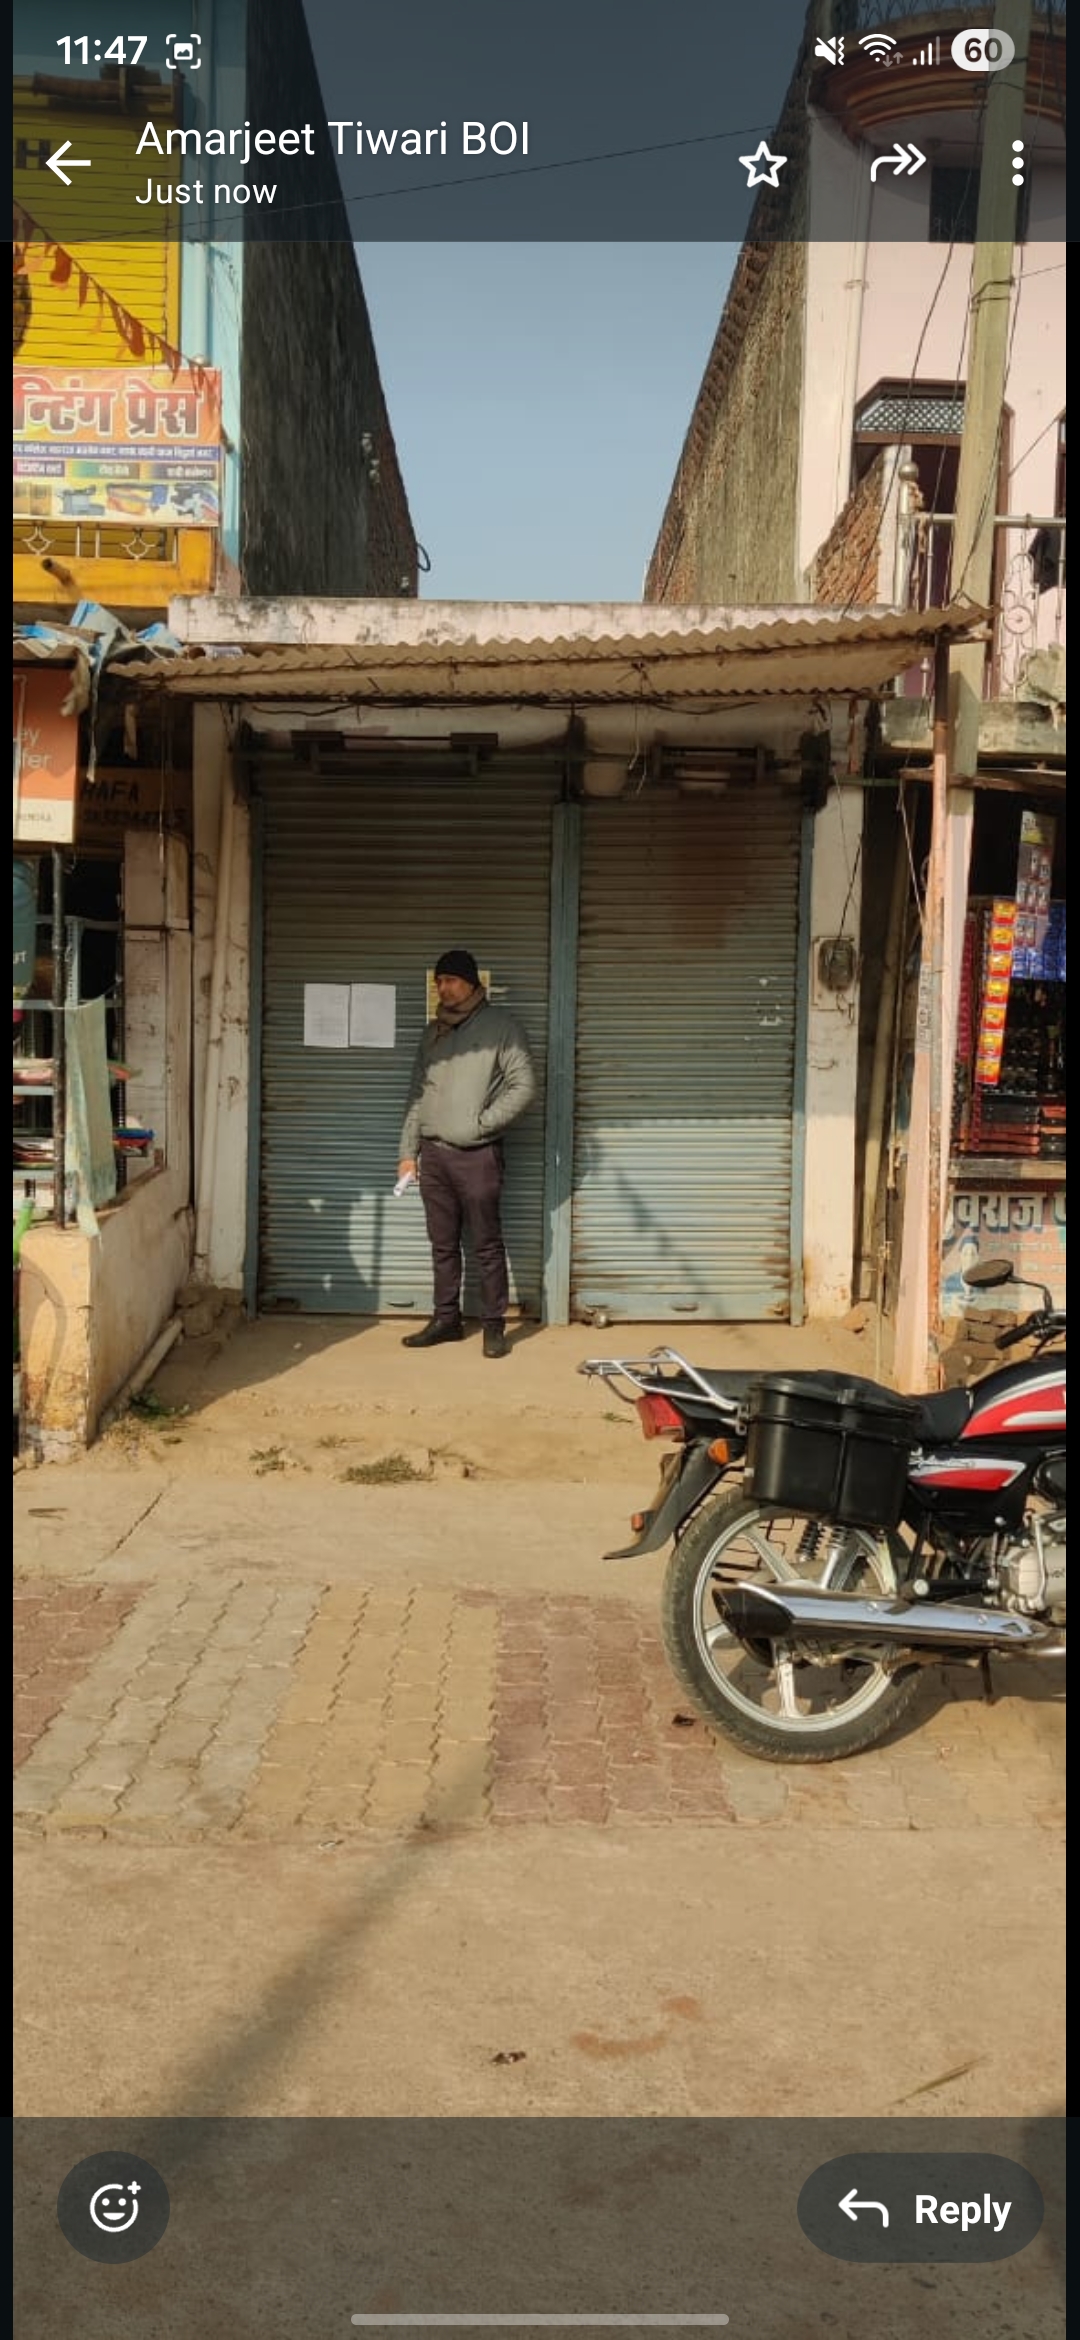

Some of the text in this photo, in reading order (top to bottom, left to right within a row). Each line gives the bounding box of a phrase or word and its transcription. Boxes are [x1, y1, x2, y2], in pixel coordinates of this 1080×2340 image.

[125, 377, 205, 439] प्रेस
[20, 728, 42, 747] ey
[21, 751, 53, 769] fer
